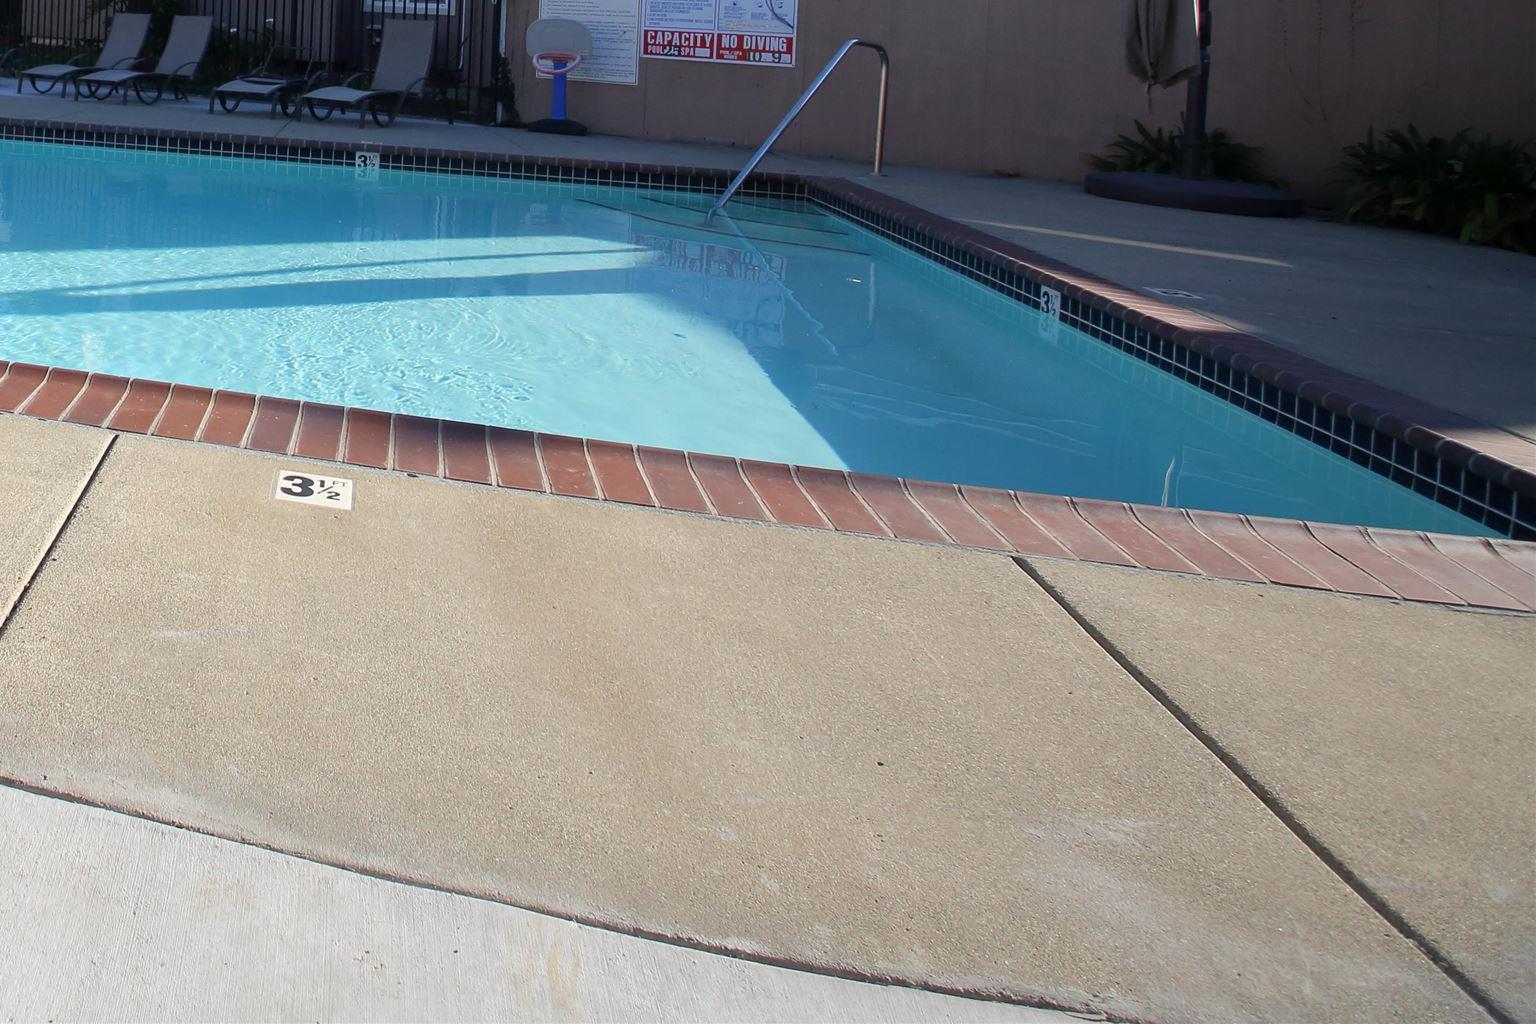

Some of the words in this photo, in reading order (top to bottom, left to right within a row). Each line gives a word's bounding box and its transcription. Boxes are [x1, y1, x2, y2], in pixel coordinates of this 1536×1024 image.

[647, 31, 712, 48] CAPACITY
[721, 34, 738, 48] NO
[743, 35, 787, 52] DIVING
[647, 45, 664, 54] POOL
[680, 47, 695, 56] SPA
